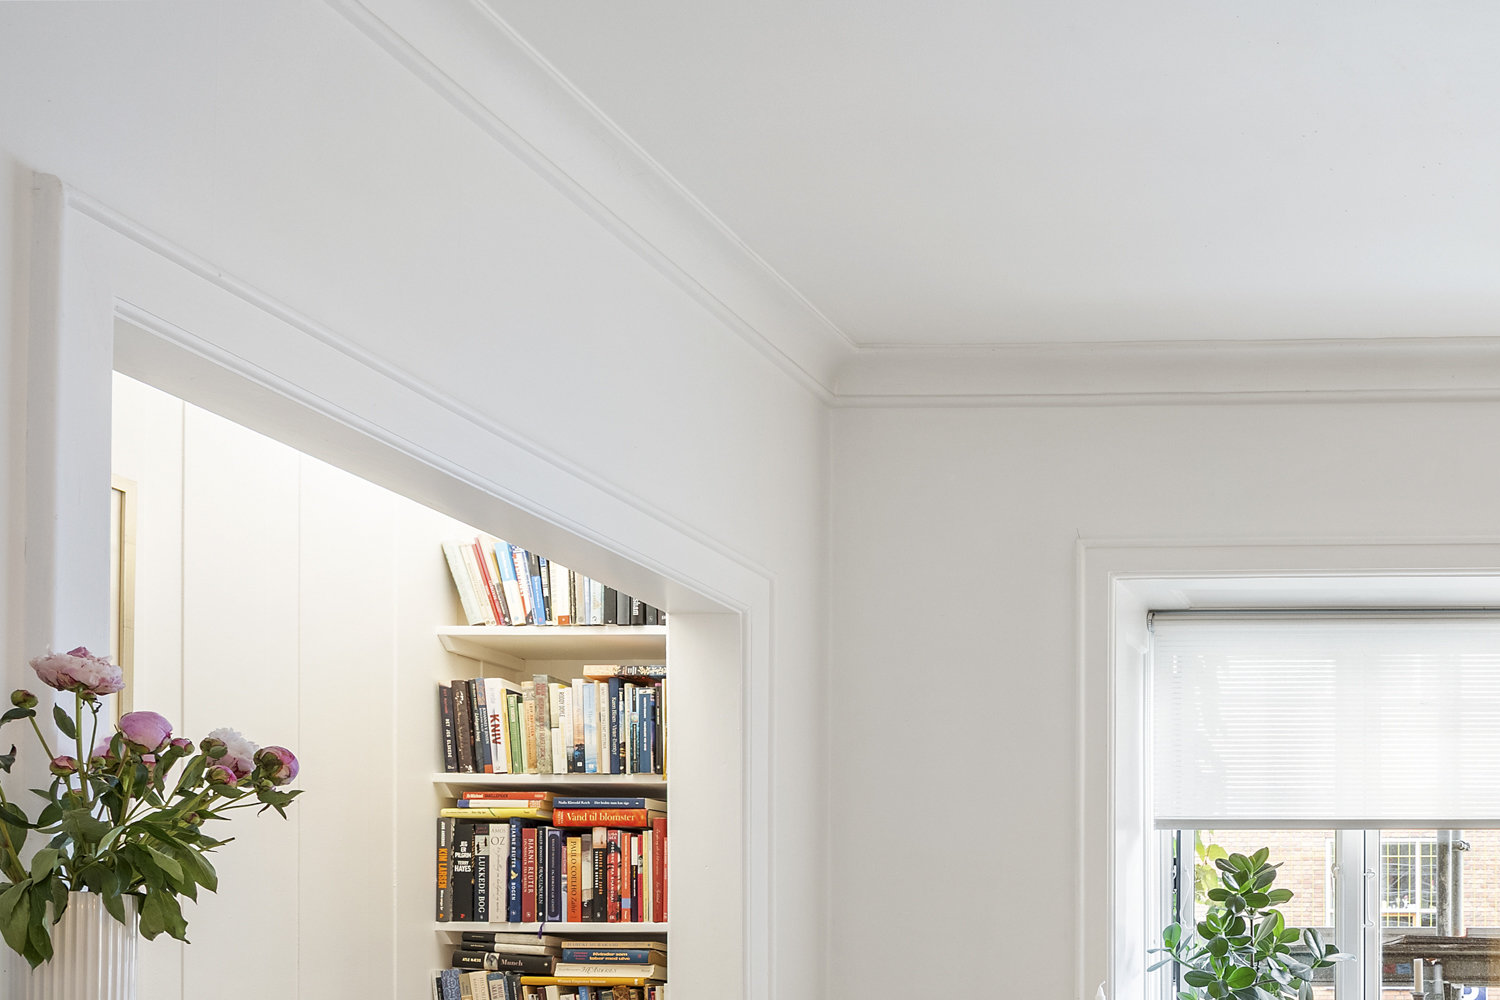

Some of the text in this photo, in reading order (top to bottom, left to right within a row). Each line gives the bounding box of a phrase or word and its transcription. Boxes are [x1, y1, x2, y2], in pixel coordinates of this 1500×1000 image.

[490, 714, 501, 745] KNIV
[566, 812, 584, 821] Vand
[589, 813, 597, 821] til
[600, 813, 635, 821] blomster
[490, 837, 505, 845] OZ
[438, 848, 447, 888] KIM LARSEN
